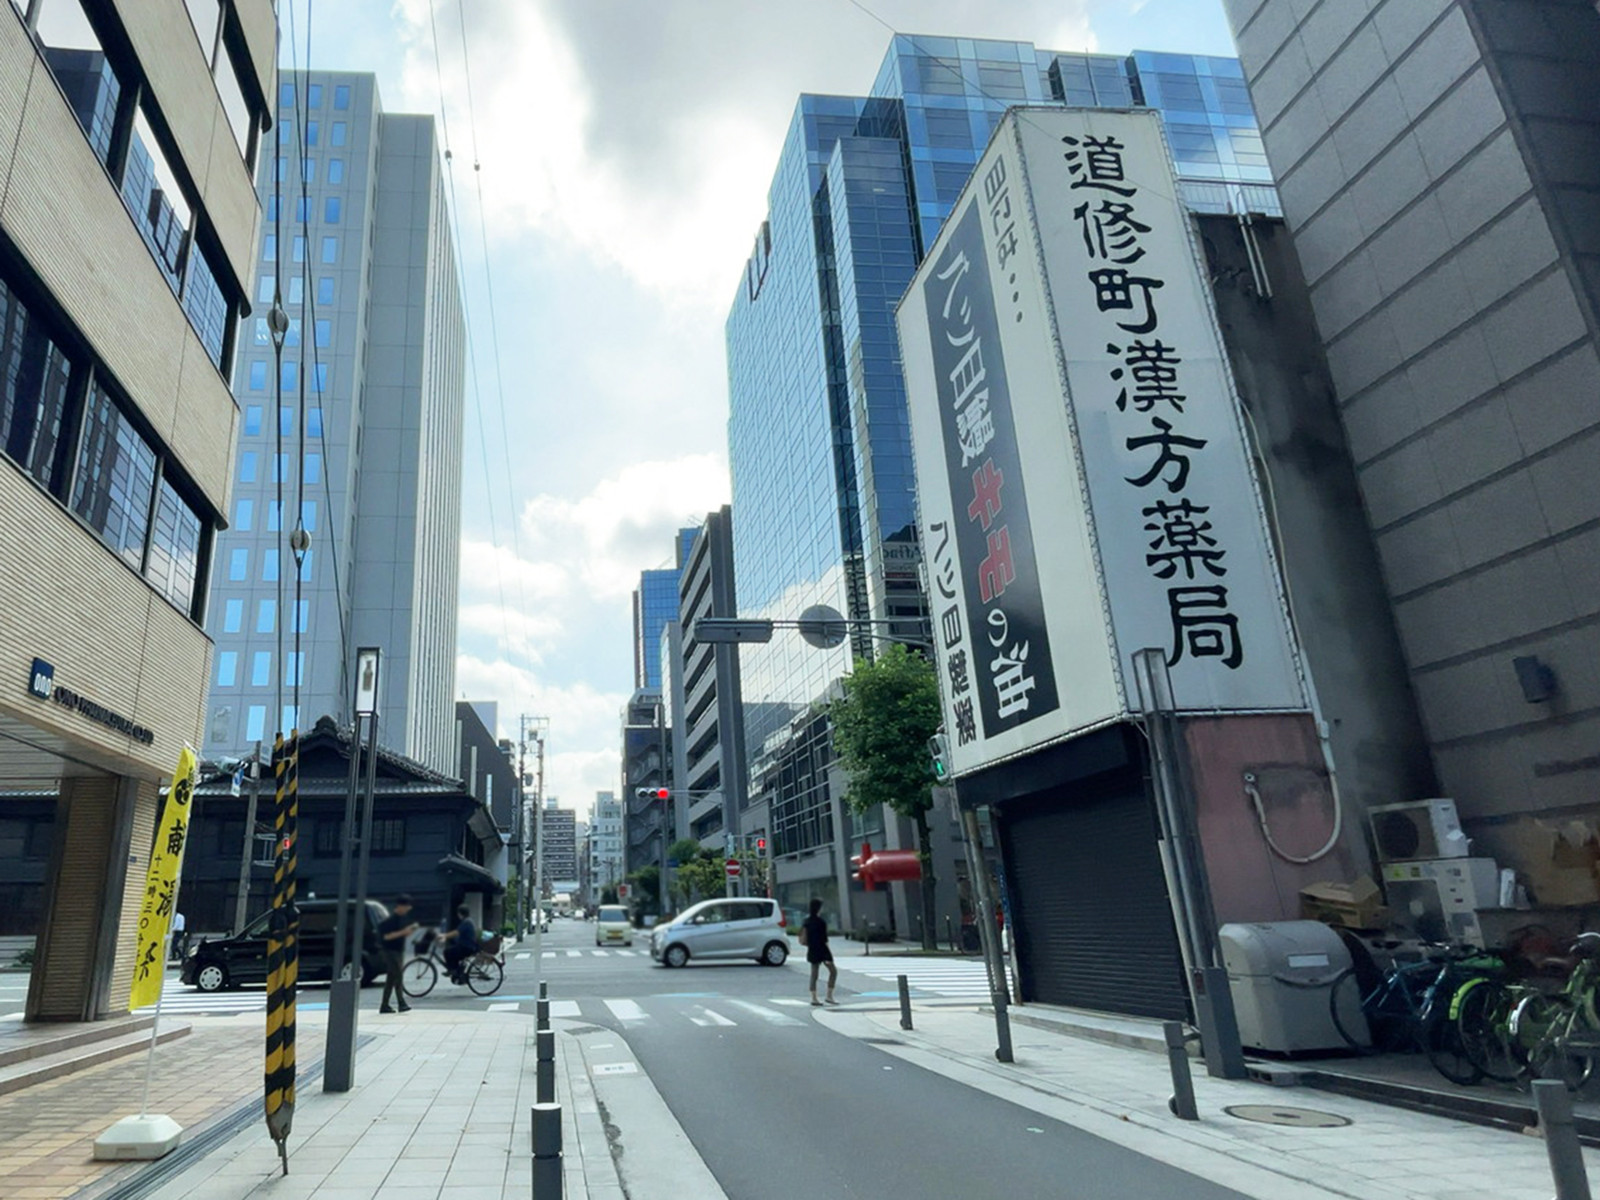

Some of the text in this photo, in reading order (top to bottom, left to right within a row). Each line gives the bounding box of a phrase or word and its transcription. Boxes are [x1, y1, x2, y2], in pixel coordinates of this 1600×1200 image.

[1061, 134, 1244, 670] 道修町漢方薬局
